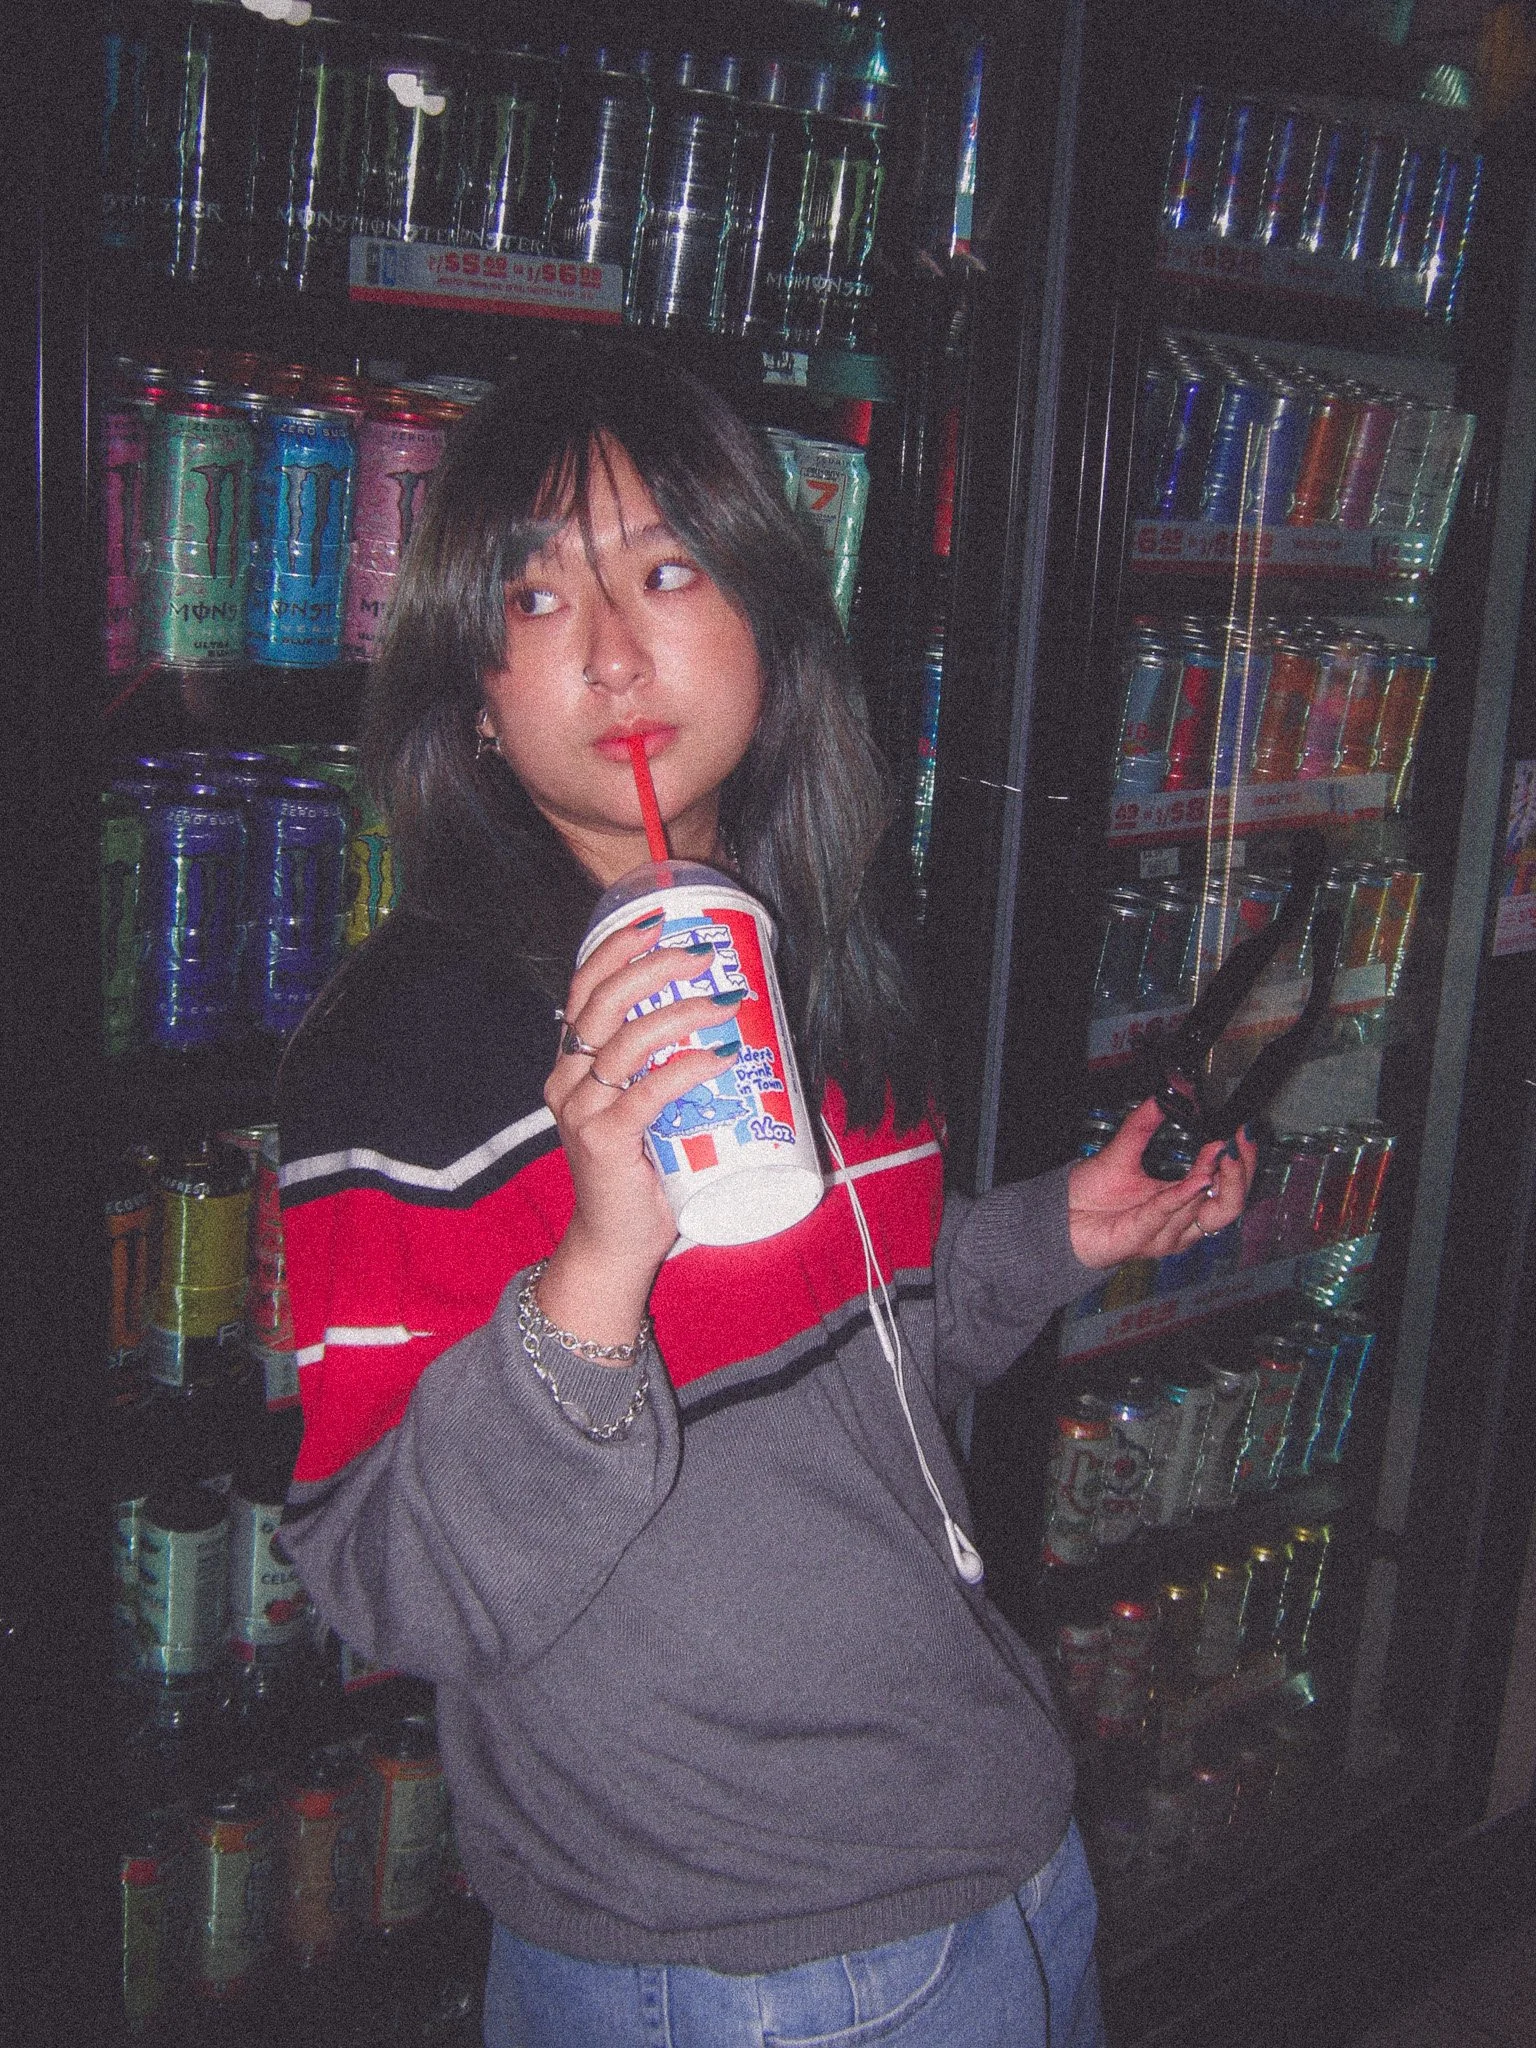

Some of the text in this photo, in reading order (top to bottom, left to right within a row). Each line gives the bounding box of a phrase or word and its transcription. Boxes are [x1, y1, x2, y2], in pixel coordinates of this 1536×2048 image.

[280, 423, 317, 436] ZERO
[736, 1062, 772, 1082] Drink
[736, 1078, 783, 1094] in Town
